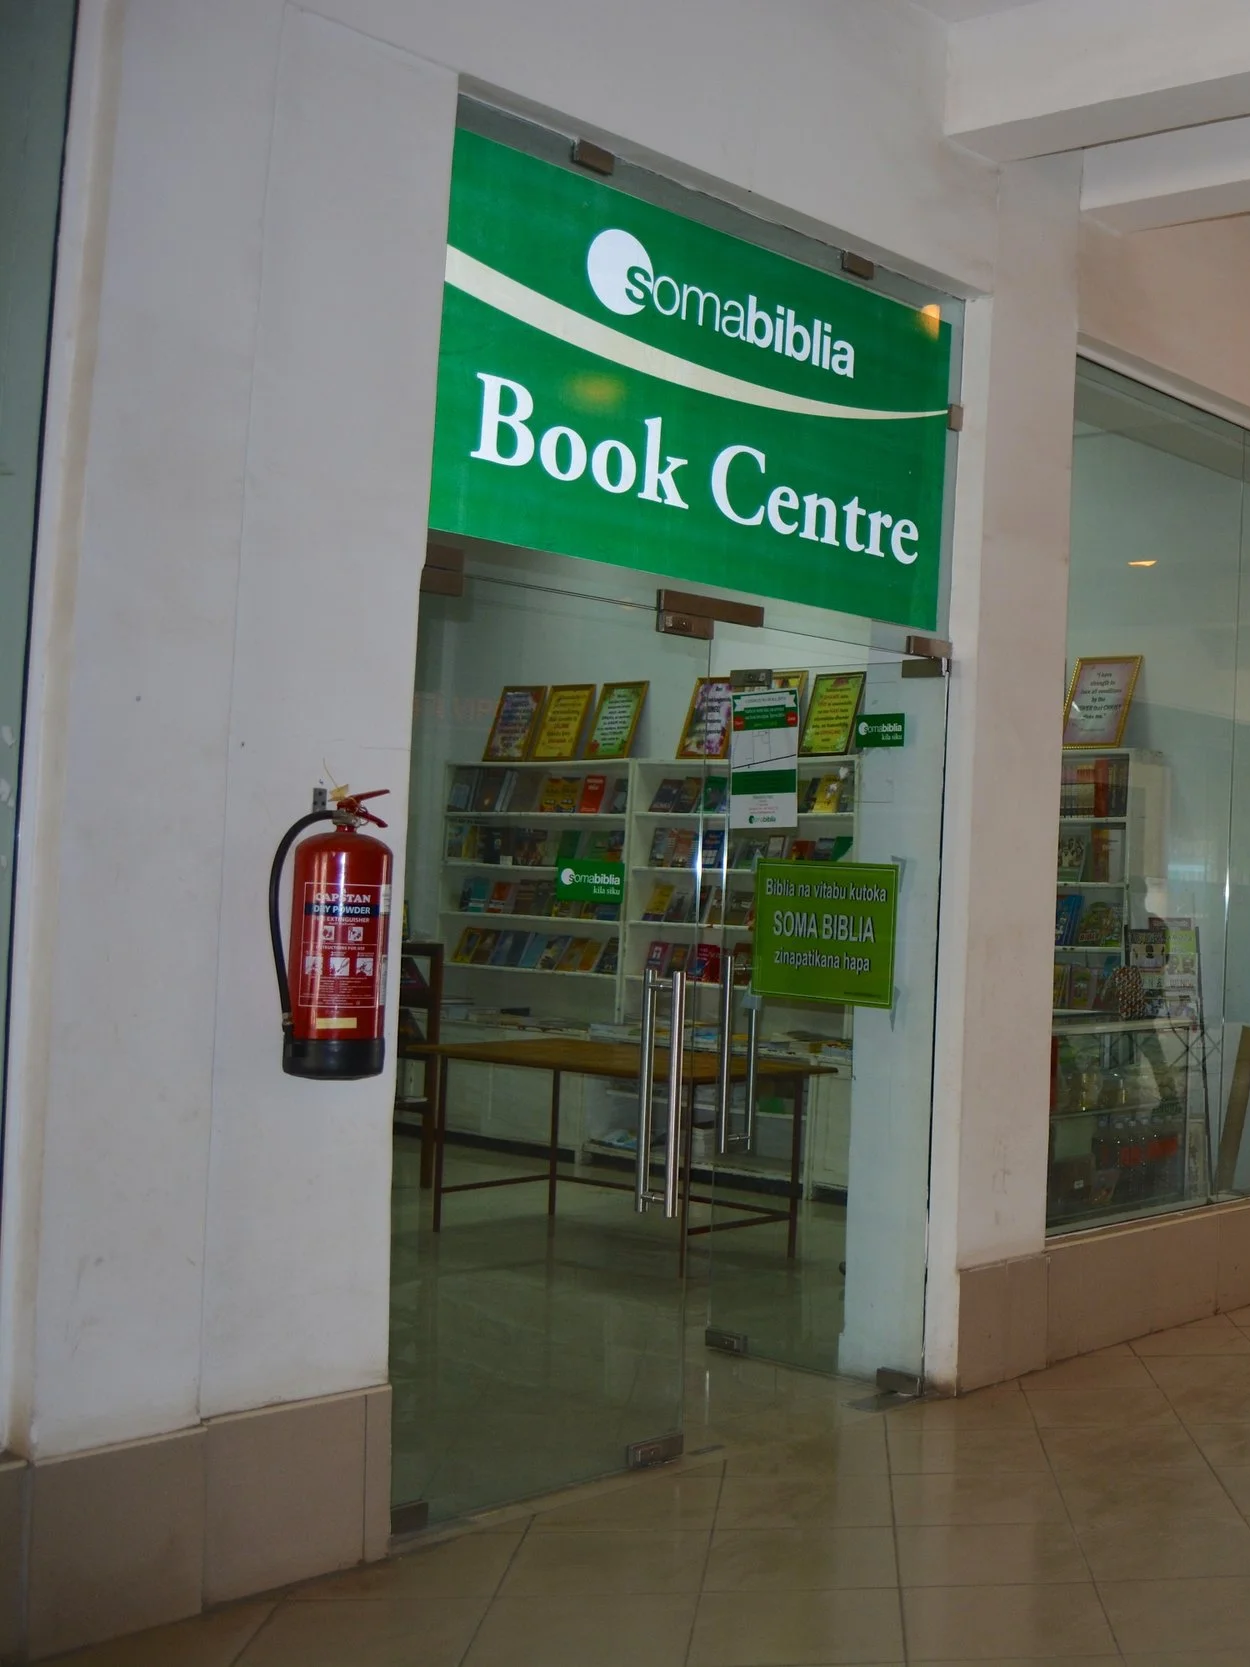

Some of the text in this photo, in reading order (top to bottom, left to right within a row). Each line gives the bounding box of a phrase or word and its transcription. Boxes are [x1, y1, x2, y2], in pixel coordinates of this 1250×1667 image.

[624, 264, 855, 379] somabiblia
[469, 372, 920, 566] Book Centre
[568, 873, 620, 885] somabiblia
[593, 886, 620, 895] kila siku
[766, 878, 887, 902] Biblia na vitabu kutoka
[315, 892, 371, 903] CAPSTAN
[333, 905, 371, 914] POWDER
[773, 910, 875, 943] SOMA BIBLIA
[774, 947, 871, 975] zinapatikana hapa
